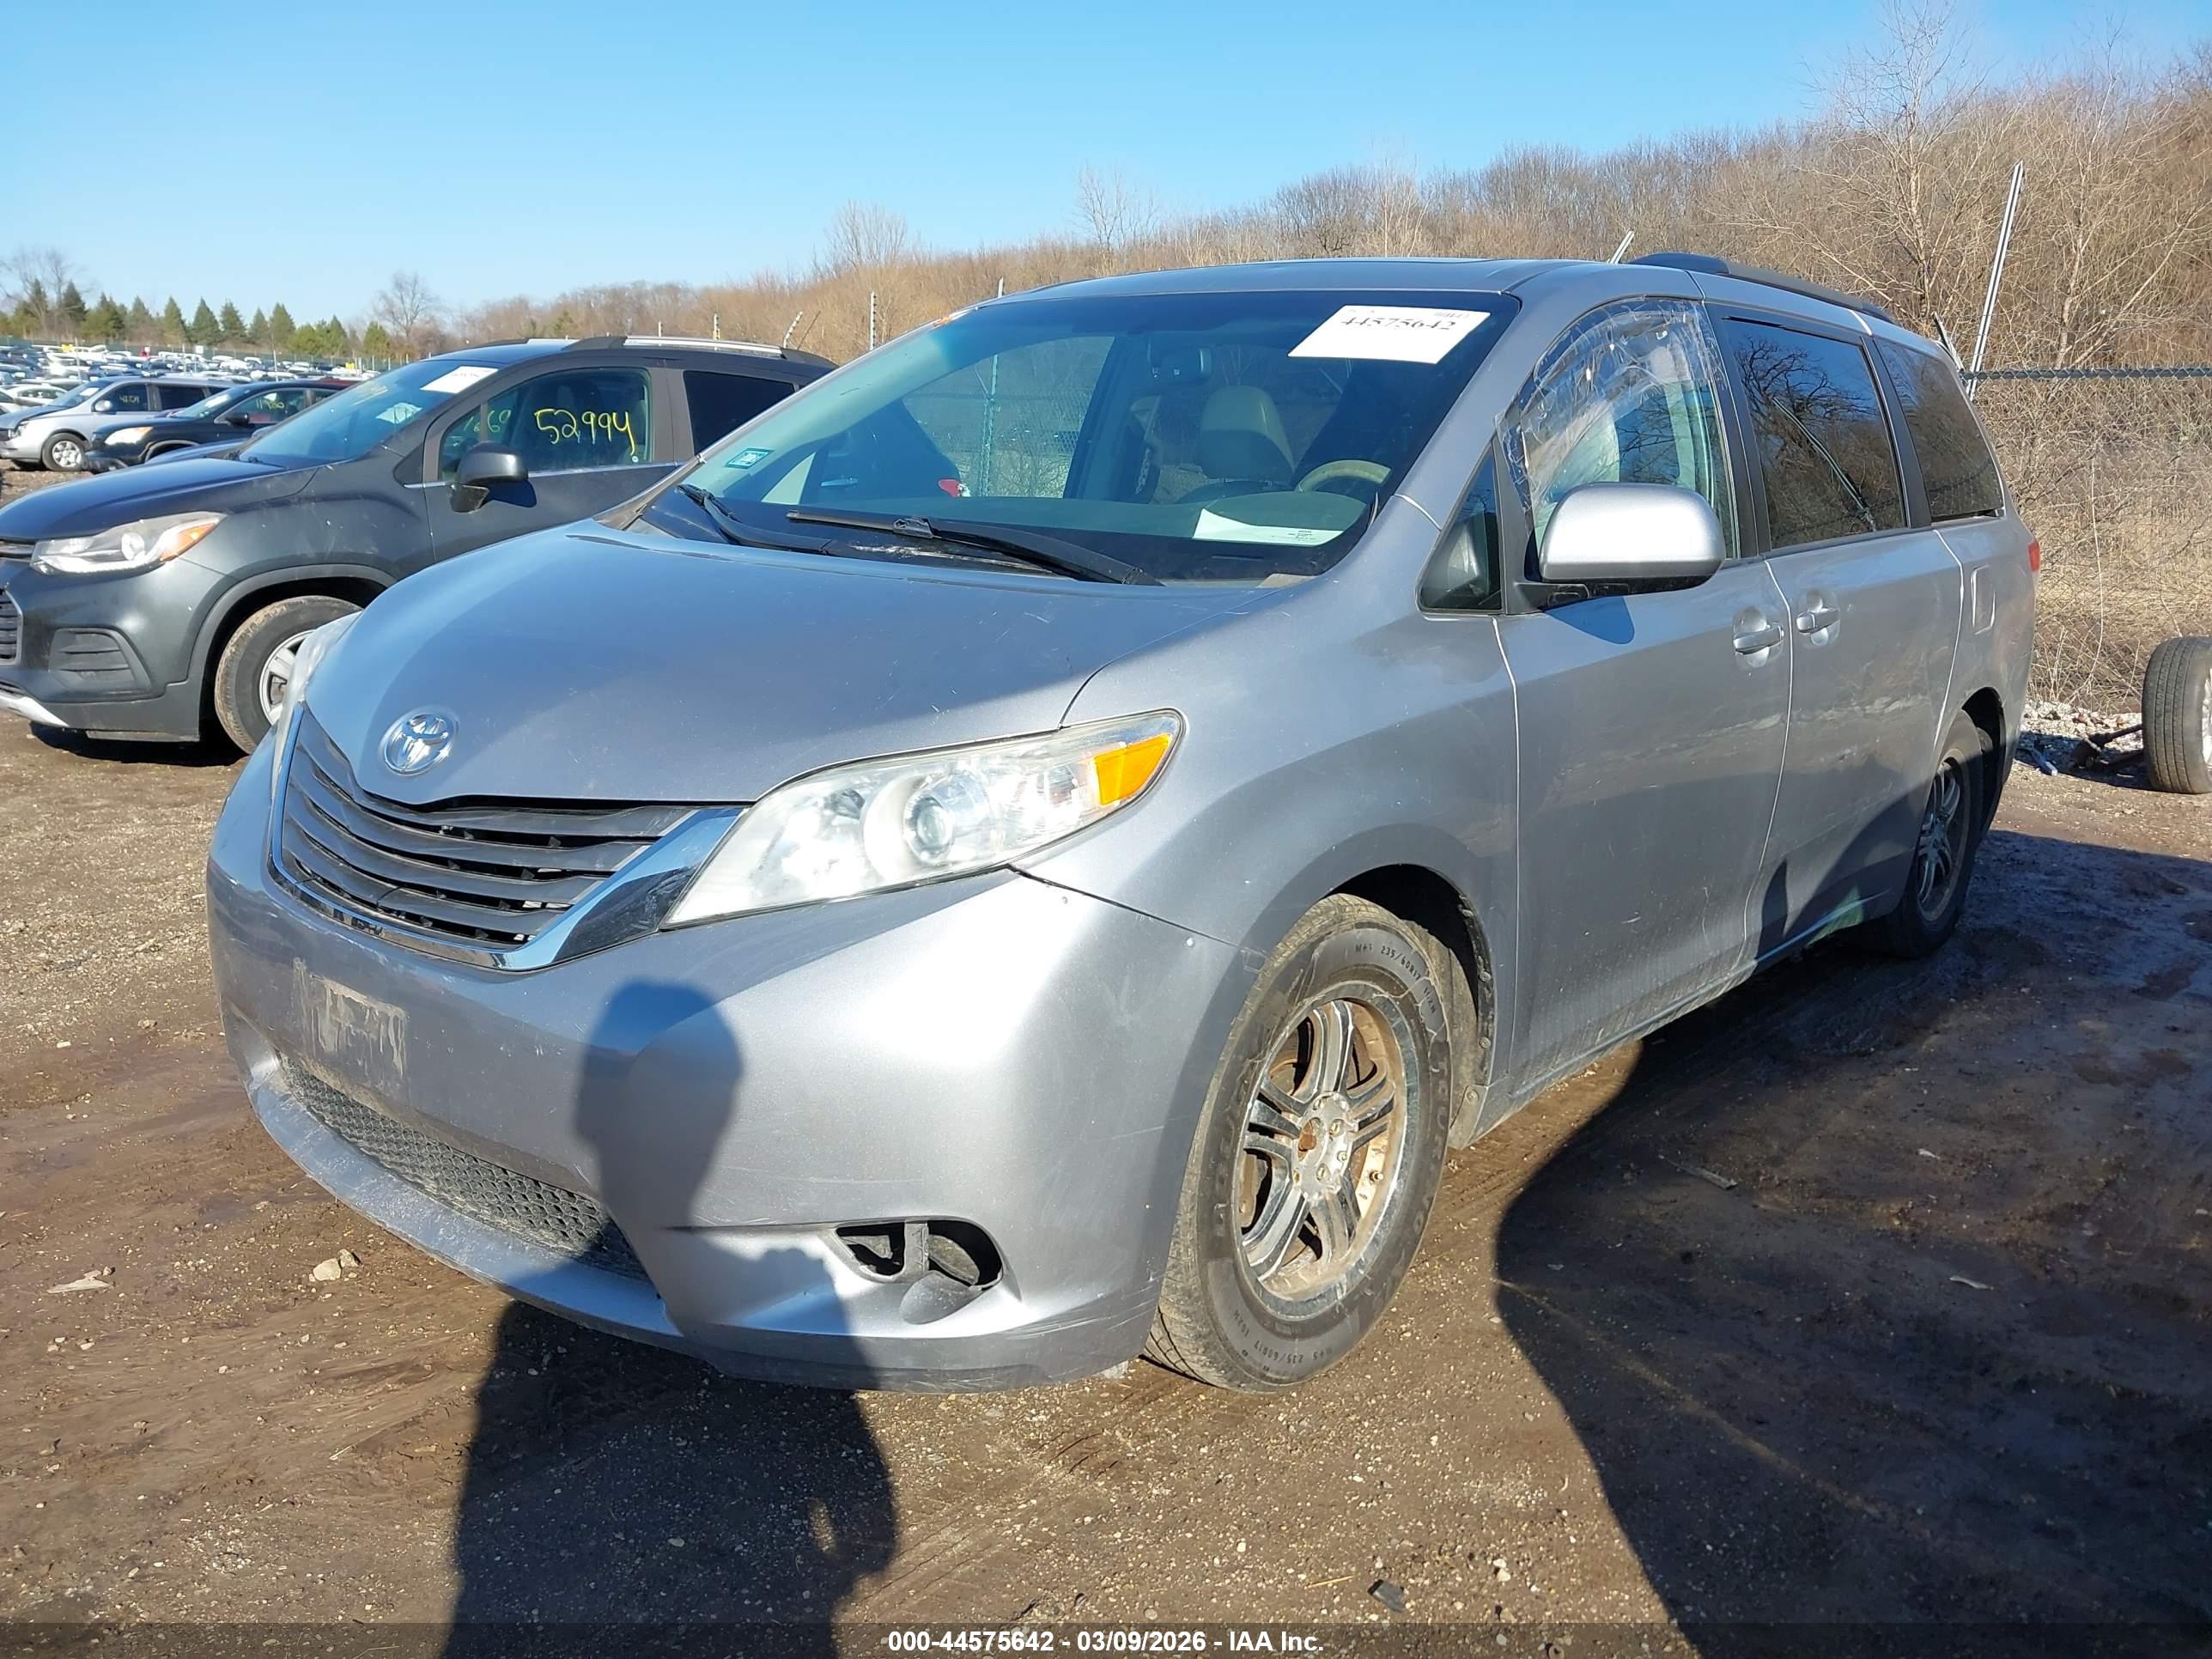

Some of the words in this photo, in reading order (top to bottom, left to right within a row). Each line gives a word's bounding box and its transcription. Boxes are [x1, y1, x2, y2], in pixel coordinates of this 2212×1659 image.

[533, 408, 635, 456] 52994
[1380, 945, 1421, 981] 235/60R17
[1254, 1340, 1304, 1364] 235/60R17
